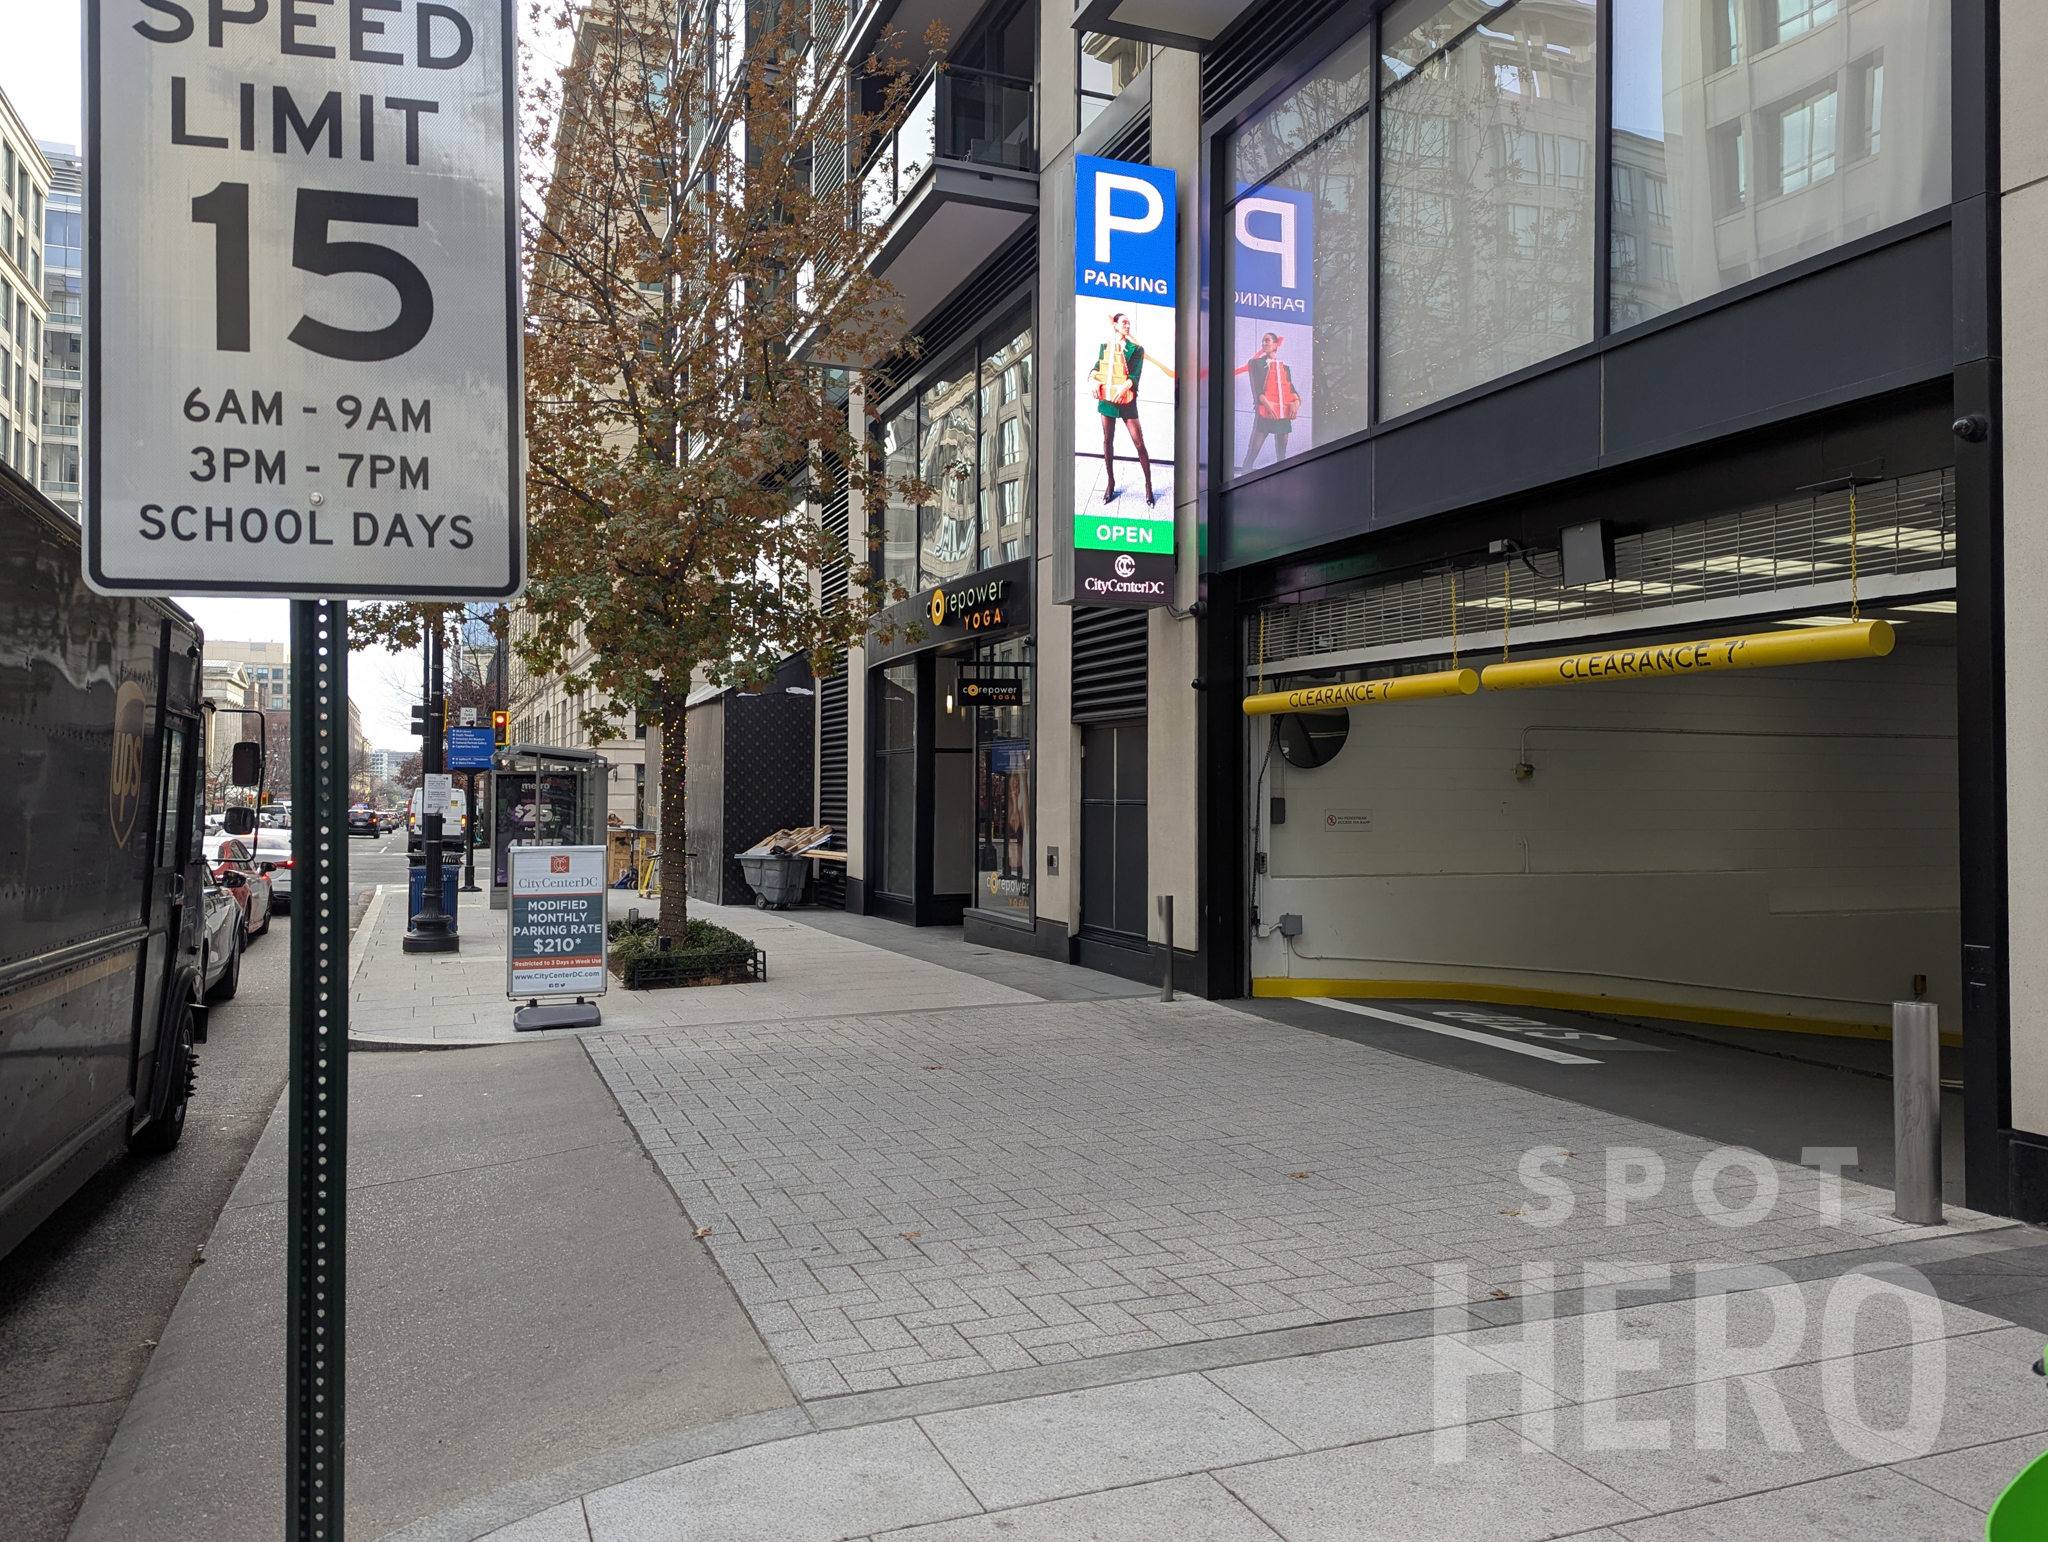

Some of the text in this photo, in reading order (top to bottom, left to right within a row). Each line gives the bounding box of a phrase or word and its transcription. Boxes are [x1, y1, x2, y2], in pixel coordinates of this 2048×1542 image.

[132, 0, 474, 70] SPEED
[171, 76, 439, 166] LIMIT
[1094, 171, 1164, 263] P
[191, 181, 434, 363] 15
[1084, 269, 1168, 295] PARKING
[183, 387, 282, 426] 6AM
[336, 394, 431, 433] 9AM
[189, 446, 286, 485] 3PM
[338, 453, 429, 491] 7PM
[139, 504, 474, 550] SCHOOL DAYS
[1096, 524, 1153, 544] OPEN
[1084, 577, 1165, 595] CityCenterDC
[925, 579, 1004, 626] corepower
[964, 607, 1002, 631] YOGA
[1558, 639, 1747, 680] CLEARANCE 7'
[962, 684, 1017, 696] corepower
[1288, 680, 1395, 709] CLEARANCE 7'
[112, 731, 141, 822] ups
[518, 876, 598, 891] CityCenterDC
[986, 872, 1030, 895] corepower
[527, 900, 588, 911] MODIFIED
[1008, 897, 1028, 909] YOGA
[513, 924, 602, 936] PARKING RATE
[527, 912, 588, 923] MONTHLY
[514, 971, 600, 981] www.CityCenterDC.com
